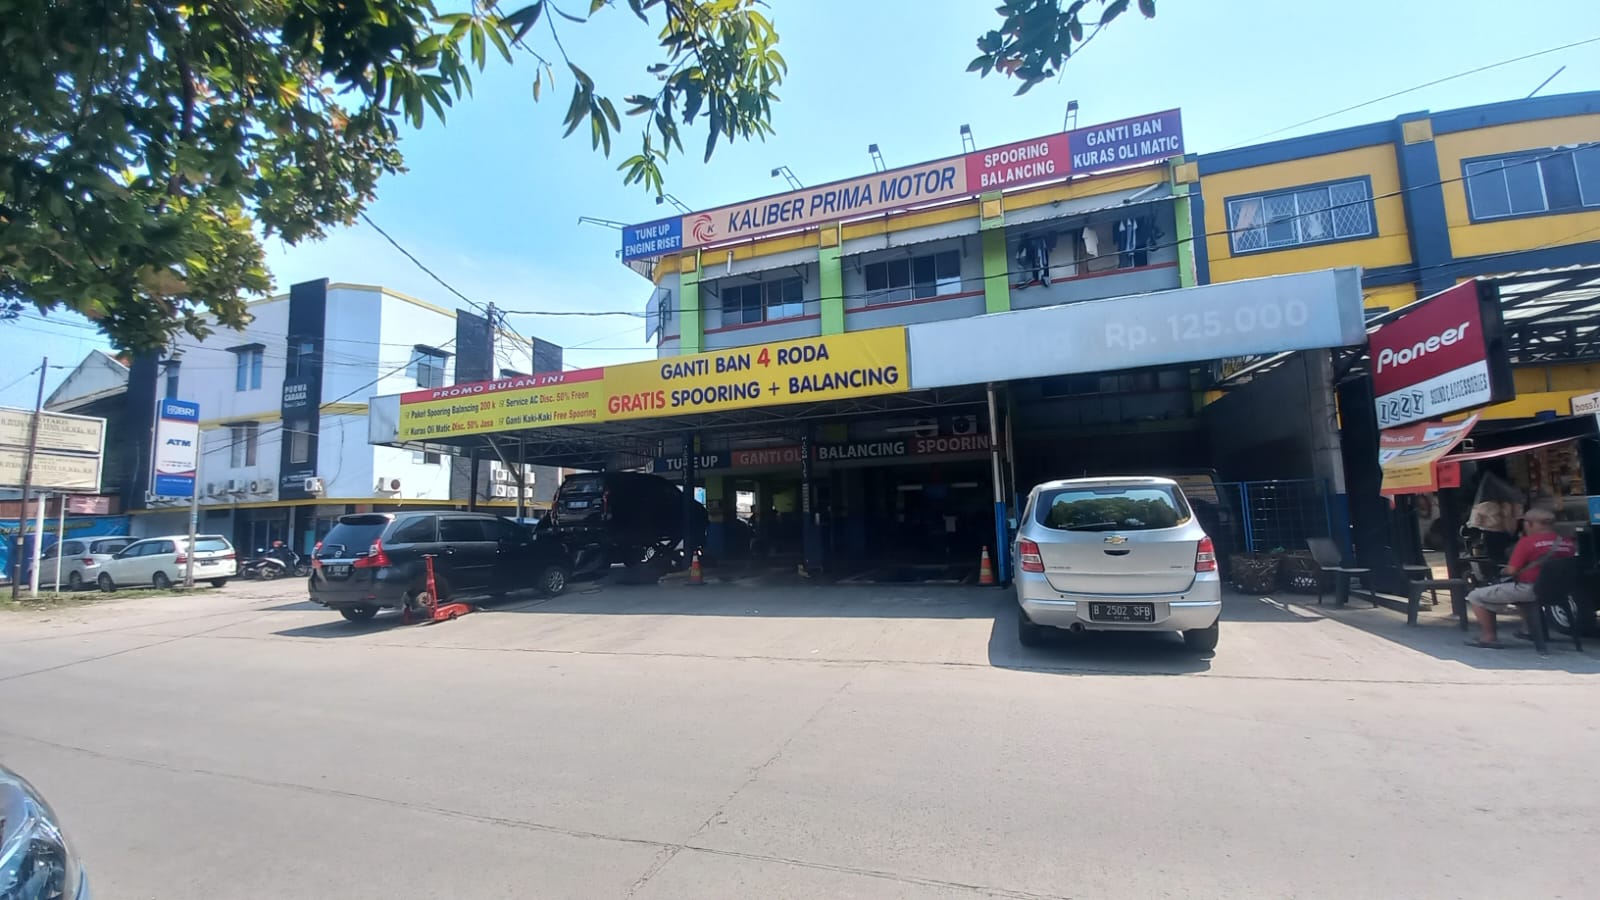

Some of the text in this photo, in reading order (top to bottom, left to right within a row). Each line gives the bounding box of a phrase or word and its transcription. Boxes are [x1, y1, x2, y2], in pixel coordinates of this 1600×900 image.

[1086, 118, 1162, 146] GANTI BAN
[984, 142, 1049, 168] SPOORING
[1073, 135, 1180, 168] KURAS OLI MATIC
[981, 160, 1055, 187] BALANCING
[727, 166, 956, 233] KALIBER PRIMA MOTOR
[635, 223, 671, 240] TUNE UP
[625, 235, 681, 256] ENGINE RISET
[1104, 321, 1157, 351] Rp.
[1167, 298, 1309, 343] 125.000
[1377, 321, 1470, 374] Pioneer
[661, 343, 829, 380] GANTI BAN 4 RODA
[432, 375, 565, 398] PROMO BULAN INI
[608, 366, 899, 414] GRATIS SPOORING + BALANCING
[506, 391, 589, 407] Service AC Disc. 50% Freon
[1379, 391, 1424, 423] IZZY
[411, 410, 426, 419] Paket
[427, 407, 451, 417] Spooring
[452, 403, 479, 414] Balancing
[480, 401, 491, 410] 200
[506, 408, 597, 425] Ganti Kaki-Kaki Free Spooring
[411, 419, 494, 435] Kuras Oli Matic Disc. 50% Jasa
[166, 438, 191, 447] ATM
[818, 441, 905, 461] BALANCING
[917, 435, 992, 454] SPOORIN
[666, 456, 698, 471] TUE
[701, 455, 718, 468] UP
[740, 447, 802, 465] GANTI OL
[1094, 605, 1150, 616] B 2502 SFB
